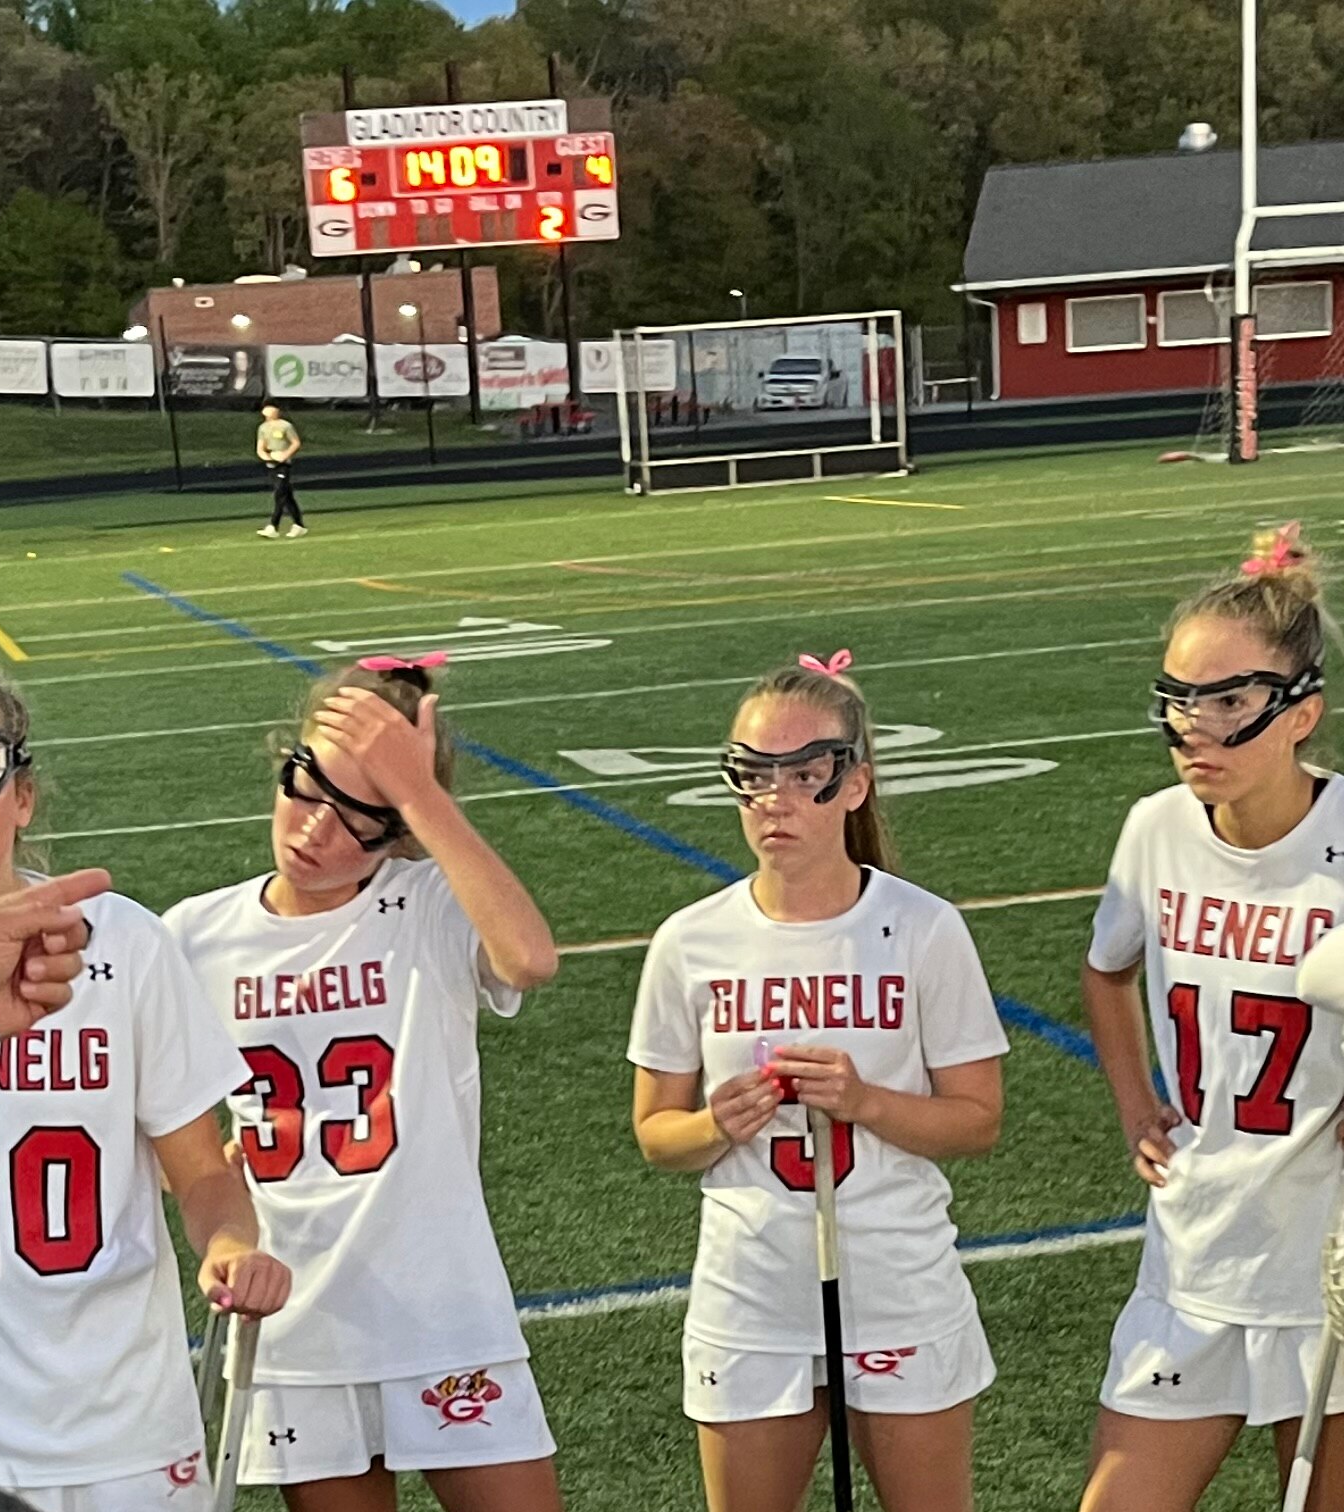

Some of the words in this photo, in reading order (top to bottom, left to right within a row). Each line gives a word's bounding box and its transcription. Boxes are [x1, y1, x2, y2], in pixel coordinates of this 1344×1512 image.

[349, 111, 466, 141] GLADIATOR
[467, 105, 563, 134] COUNTRY
[329, 167, 356, 202] 6
[585, 154, 613, 185] 4
[539, 206, 564, 239] 2
[1159, 887, 1335, 967] GLENELG
[234, 960, 388, 1020] GLENELG
[709, 974, 905, 1034] GLENELG
[1166, 982, 1312, 1137] 17
[233, 1034, 400, 1183] 33
